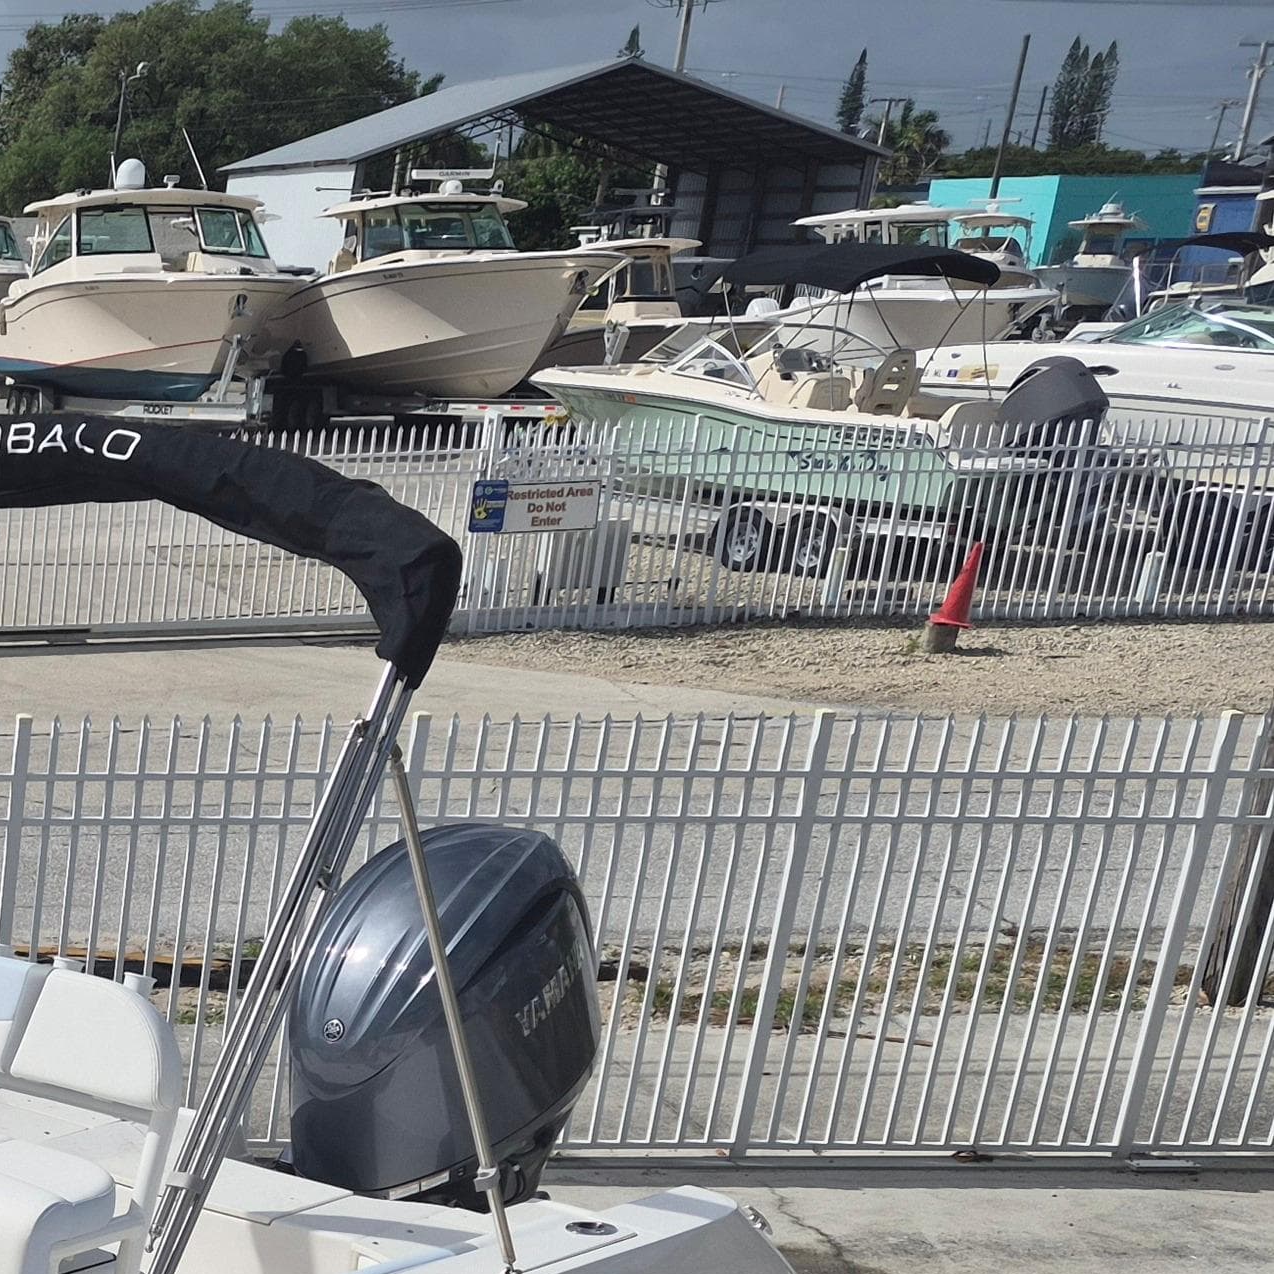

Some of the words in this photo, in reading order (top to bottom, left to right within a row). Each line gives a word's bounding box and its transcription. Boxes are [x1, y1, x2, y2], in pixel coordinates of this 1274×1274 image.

[507, 487, 564, 500] Restricted
[566, 486, 593, 498] Area
[527, 503, 543, 513] Do
[546, 501, 566, 512] Not
[531, 516, 562, 527] Enter
